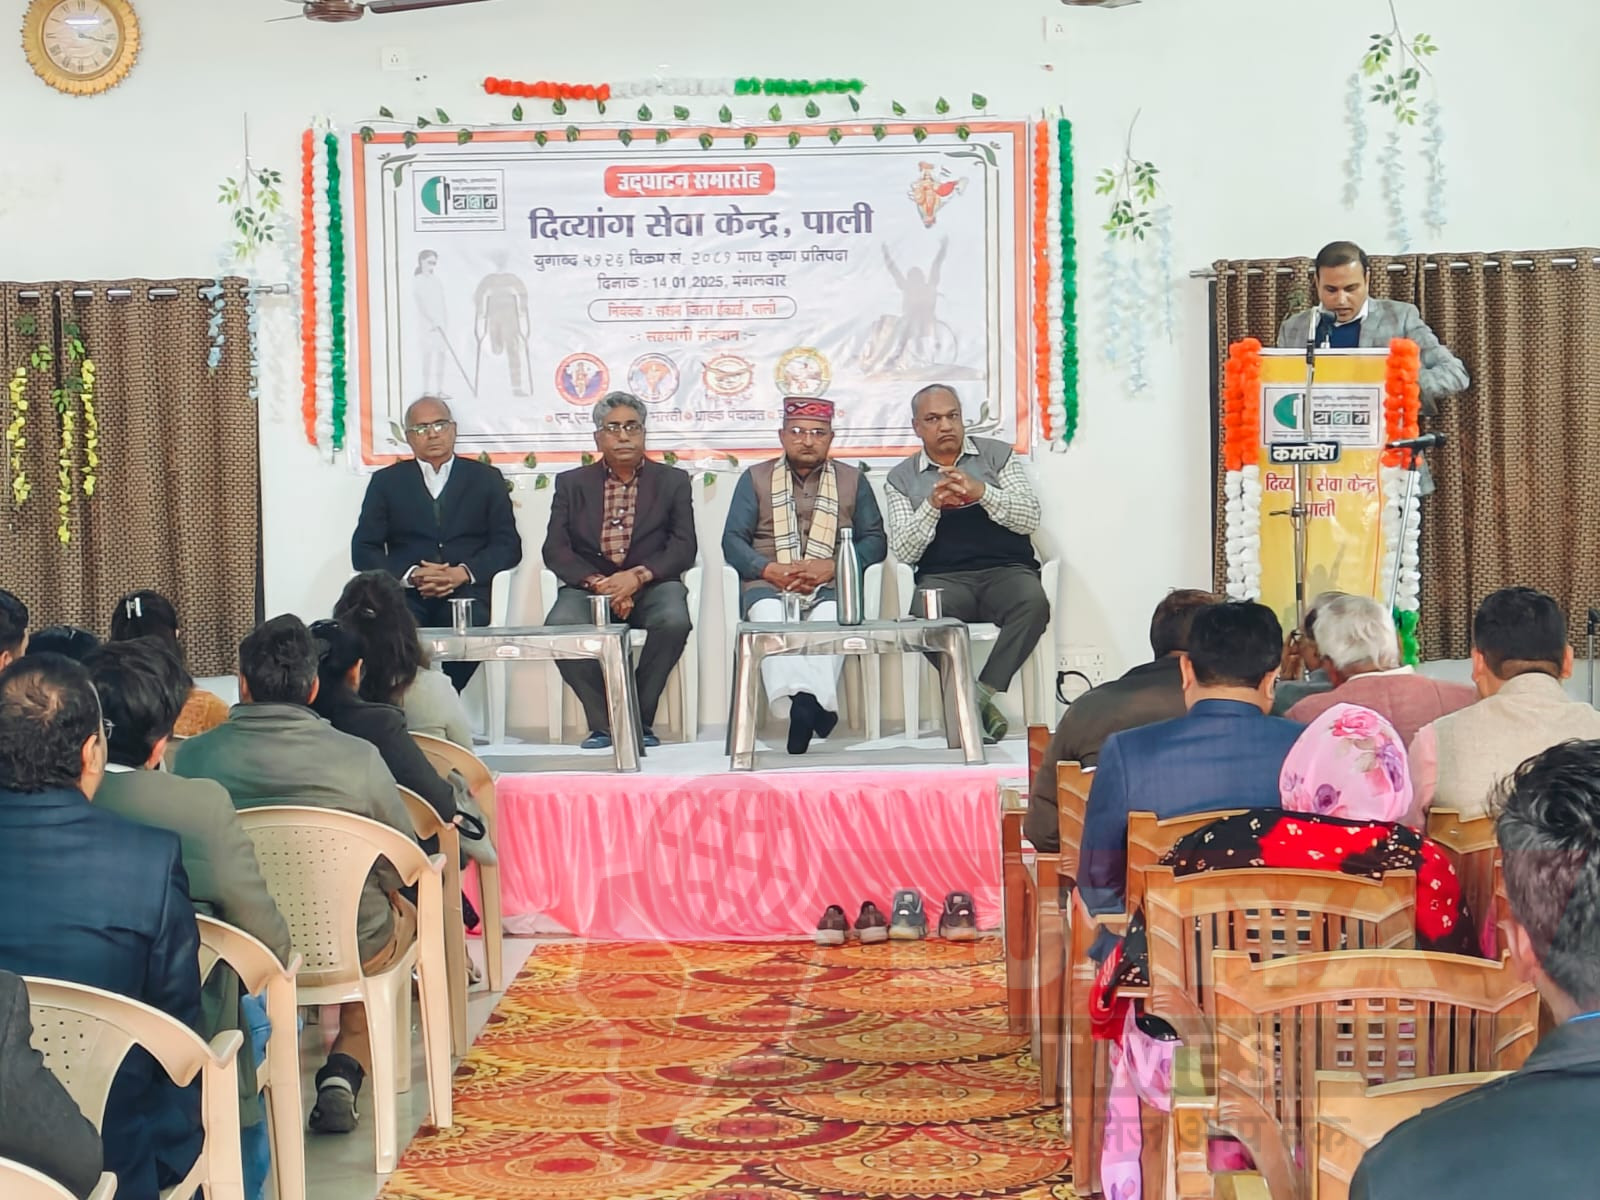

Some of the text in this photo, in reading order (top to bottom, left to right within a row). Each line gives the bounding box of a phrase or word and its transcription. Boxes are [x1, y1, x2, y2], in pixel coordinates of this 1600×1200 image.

[693, 166, 763, 190] समारोह
[528, 201, 874, 240] दिव्यांग सेवा केन्द्र, पाली
[800, 244, 849, 263] प्रतिपदा
[1272, 442, 1337, 462] कमलेश
[1316, 474, 1343, 492] सेवा
[1346, 473, 1377, 493] केन्द्र
[1304, 498, 1336, 517] पाली
